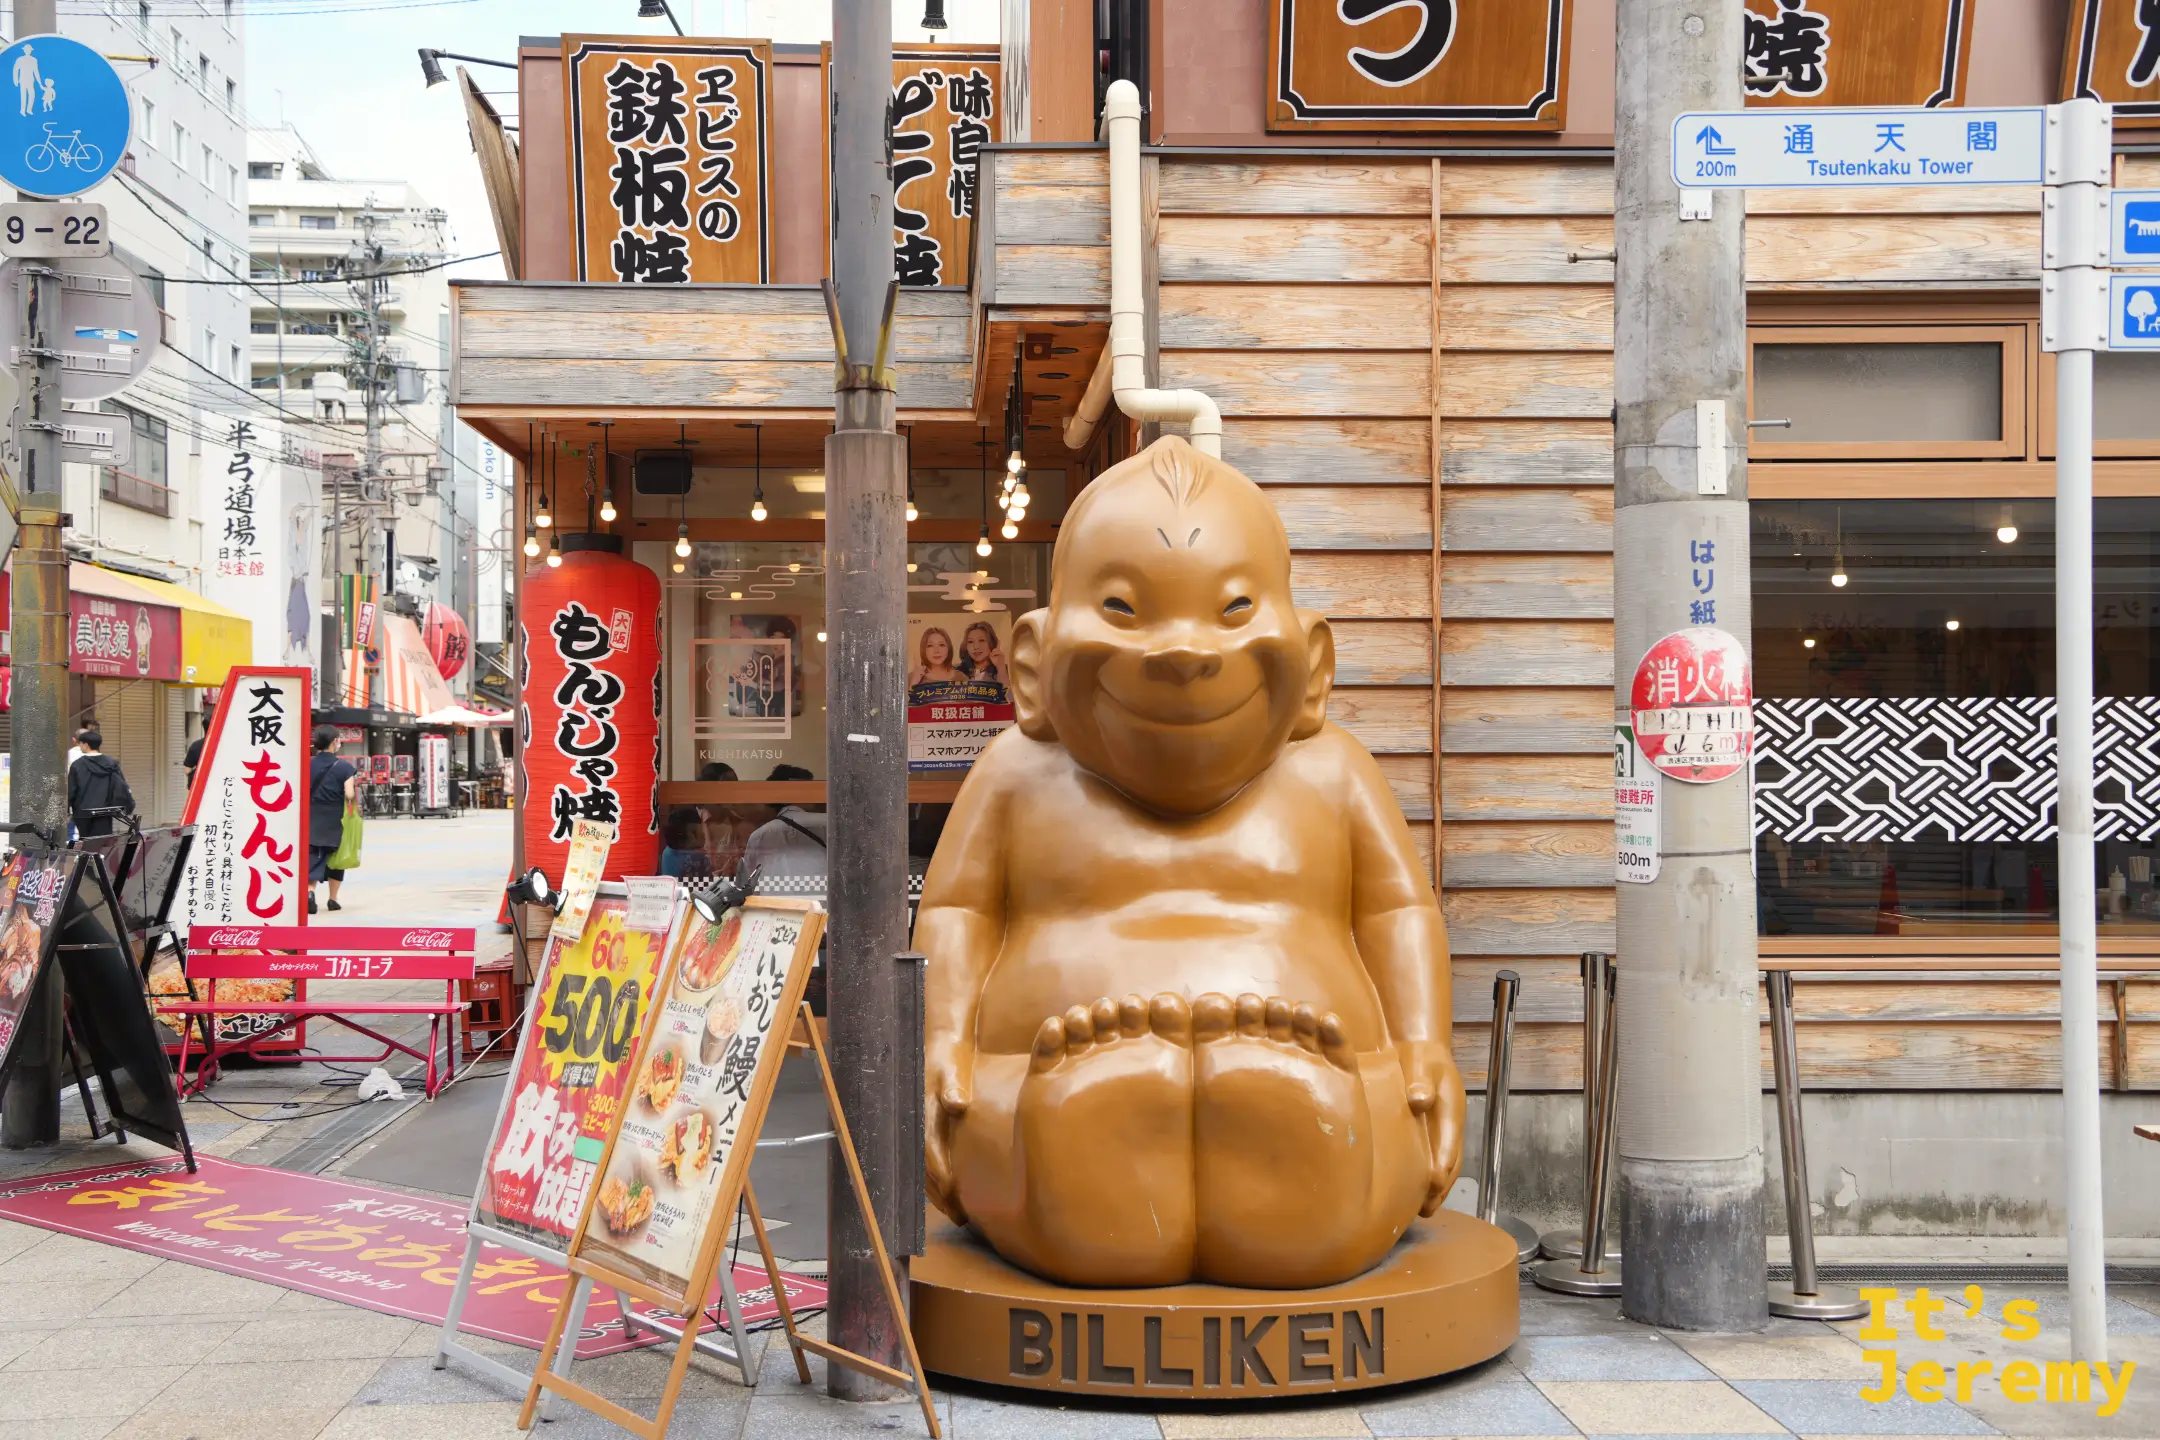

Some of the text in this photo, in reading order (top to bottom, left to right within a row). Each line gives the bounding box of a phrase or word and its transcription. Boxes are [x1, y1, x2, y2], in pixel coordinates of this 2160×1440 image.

[1783, 123, 1997, 154] 通天閣
[1696, 160, 1737, 177] 200m
[1807, 156, 1974, 177] Tsutenkaku Tower
[7, 217, 24, 244] 9
[63, 217, 101, 244] 22
[224, 420, 257, 546] 半弓道場
[218, 547, 262, 560] 日本一
[1689, 539, 1716, 625] はり紙
[75, 613, 132, 659] 美味苑
[612, 613, 628, 645] 大阪
[916, 686, 998, 699] プレミアム付商品券
[549, 601, 625, 844] もんじゃ焼
[931, 706, 985, 720] 取扱店舗
[699, 749, 783, 760] KUSHIKATSU
[1618, 852, 1651, 868] 500m
[208, 929, 264, 948] Coca-Cola
[401, 930, 455, 949] Coca-Cola
[324, 956, 394, 978] コカ・コーラ
[1008, 1307, 1385, 1388] BILLIKEN
